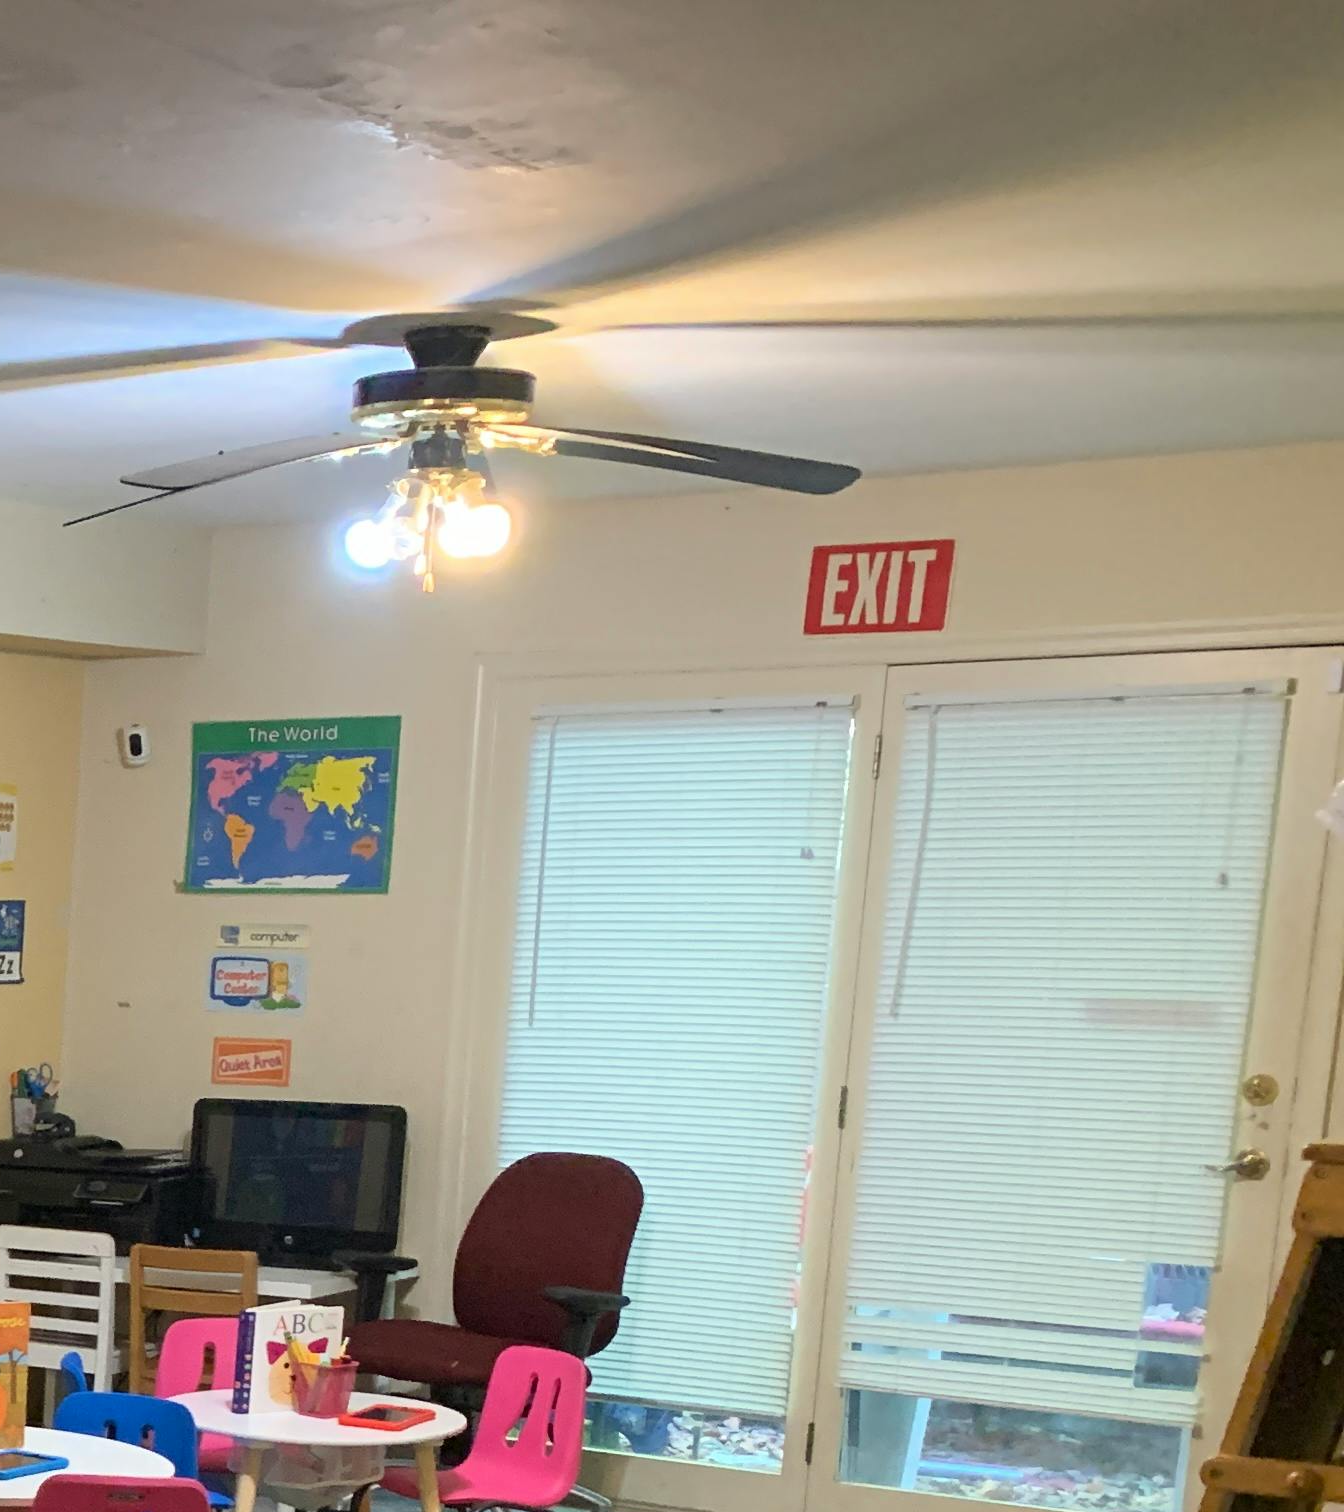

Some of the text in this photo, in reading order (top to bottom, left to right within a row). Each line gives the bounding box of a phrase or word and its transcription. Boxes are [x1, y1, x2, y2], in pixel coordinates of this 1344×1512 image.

[820, 549, 937, 627] EXIT
[248, 725, 339, 743] The World
[250, 932, 299, 945] computer
[216, 969, 267, 984] Computer
[220, 1054, 282, 1072] Quiet Area
[273, 1313, 324, 1336] ABC
